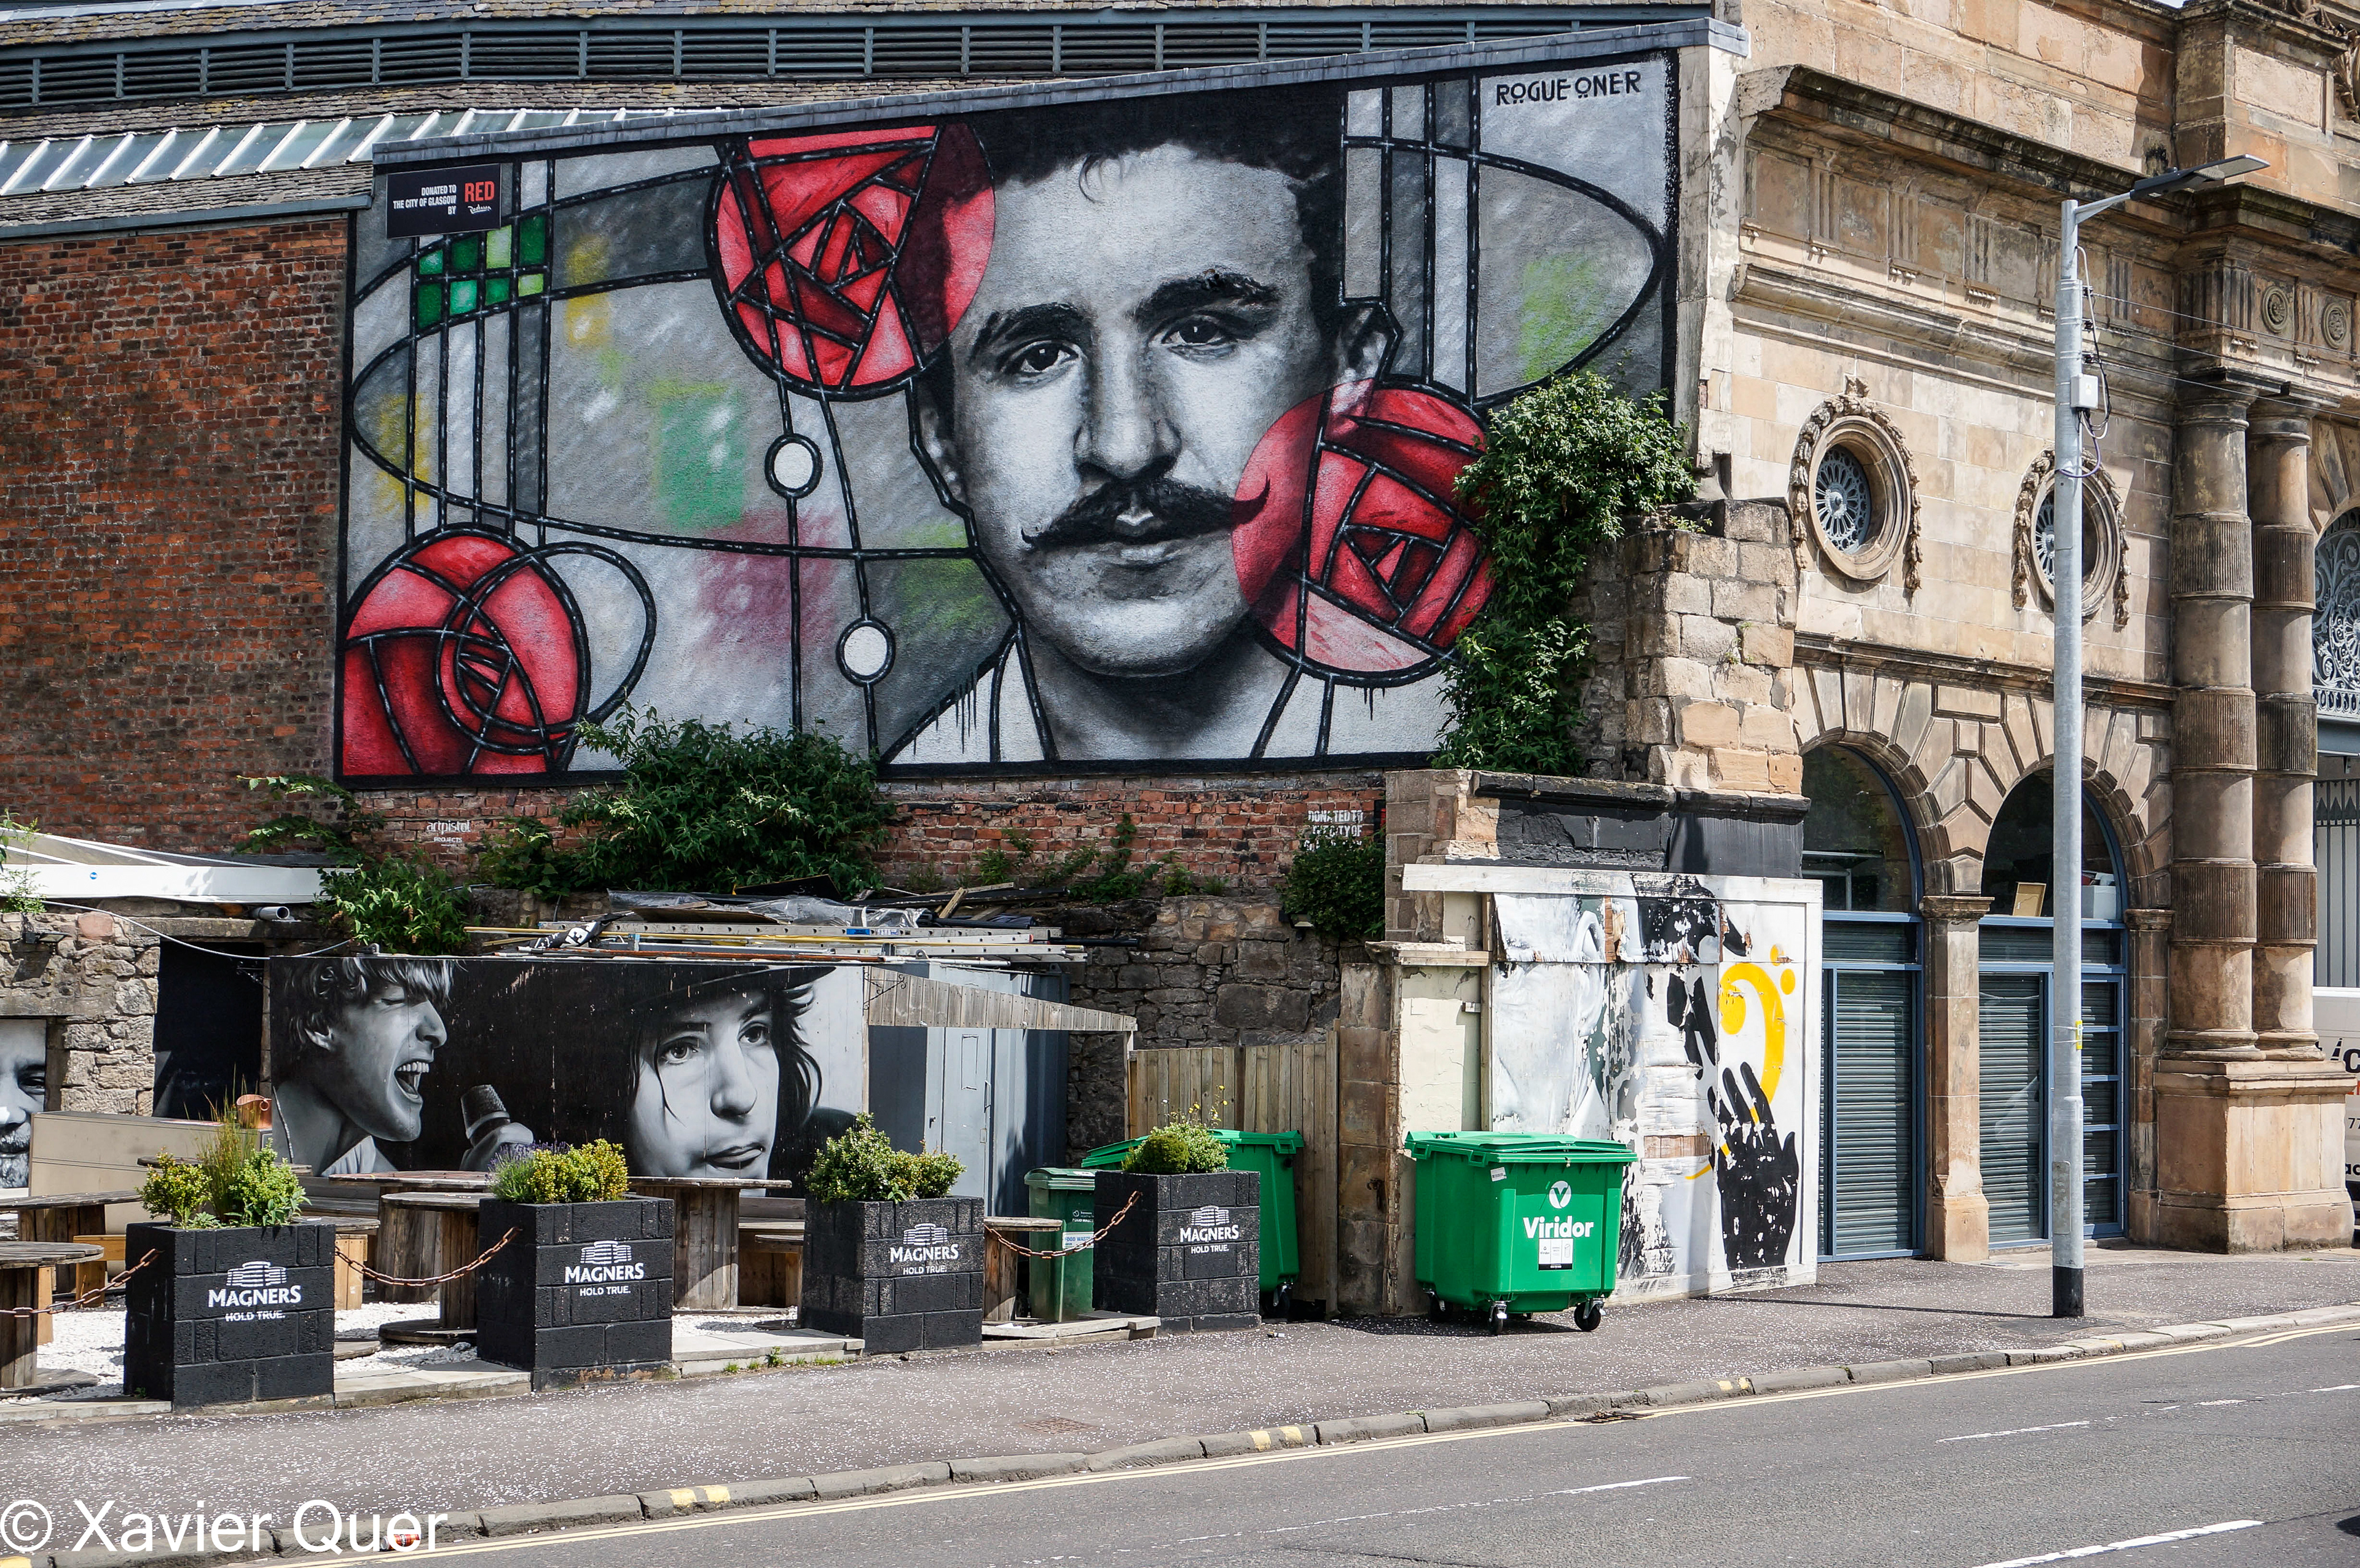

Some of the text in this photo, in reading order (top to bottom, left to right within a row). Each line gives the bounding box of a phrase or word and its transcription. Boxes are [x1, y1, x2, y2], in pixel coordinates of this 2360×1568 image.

[1496, 71, 1641, 106] ROGUE ONER
[421, 184, 457, 196] DONATED TO
[465, 181, 495, 202] RED
[393, 195, 457, 210] THE CITY OF GLASGOW
[447, 206, 457, 215] BY
[1308, 810, 1350, 822] DONATED
[427, 820, 471, 834] artpistol
[1351, 825, 1363, 837] OF
[1523, 1215, 1594, 1238] Viridor
[1179, 1225, 1239, 1243] MAGNERS
[890, 1243, 959, 1263] MAGNERS
[1190, 1245, 1210, 1254] HOLD
[564, 1262, 645, 1284] MAGNERS
[903, 1265, 947, 1275] HOLD TRUE.
[208, 1285, 302, 1307] MAGNERS
[580, 1285, 631, 1296] HOLD TRUE.
[225, 1310, 286, 1322] HOLD TRUE.
